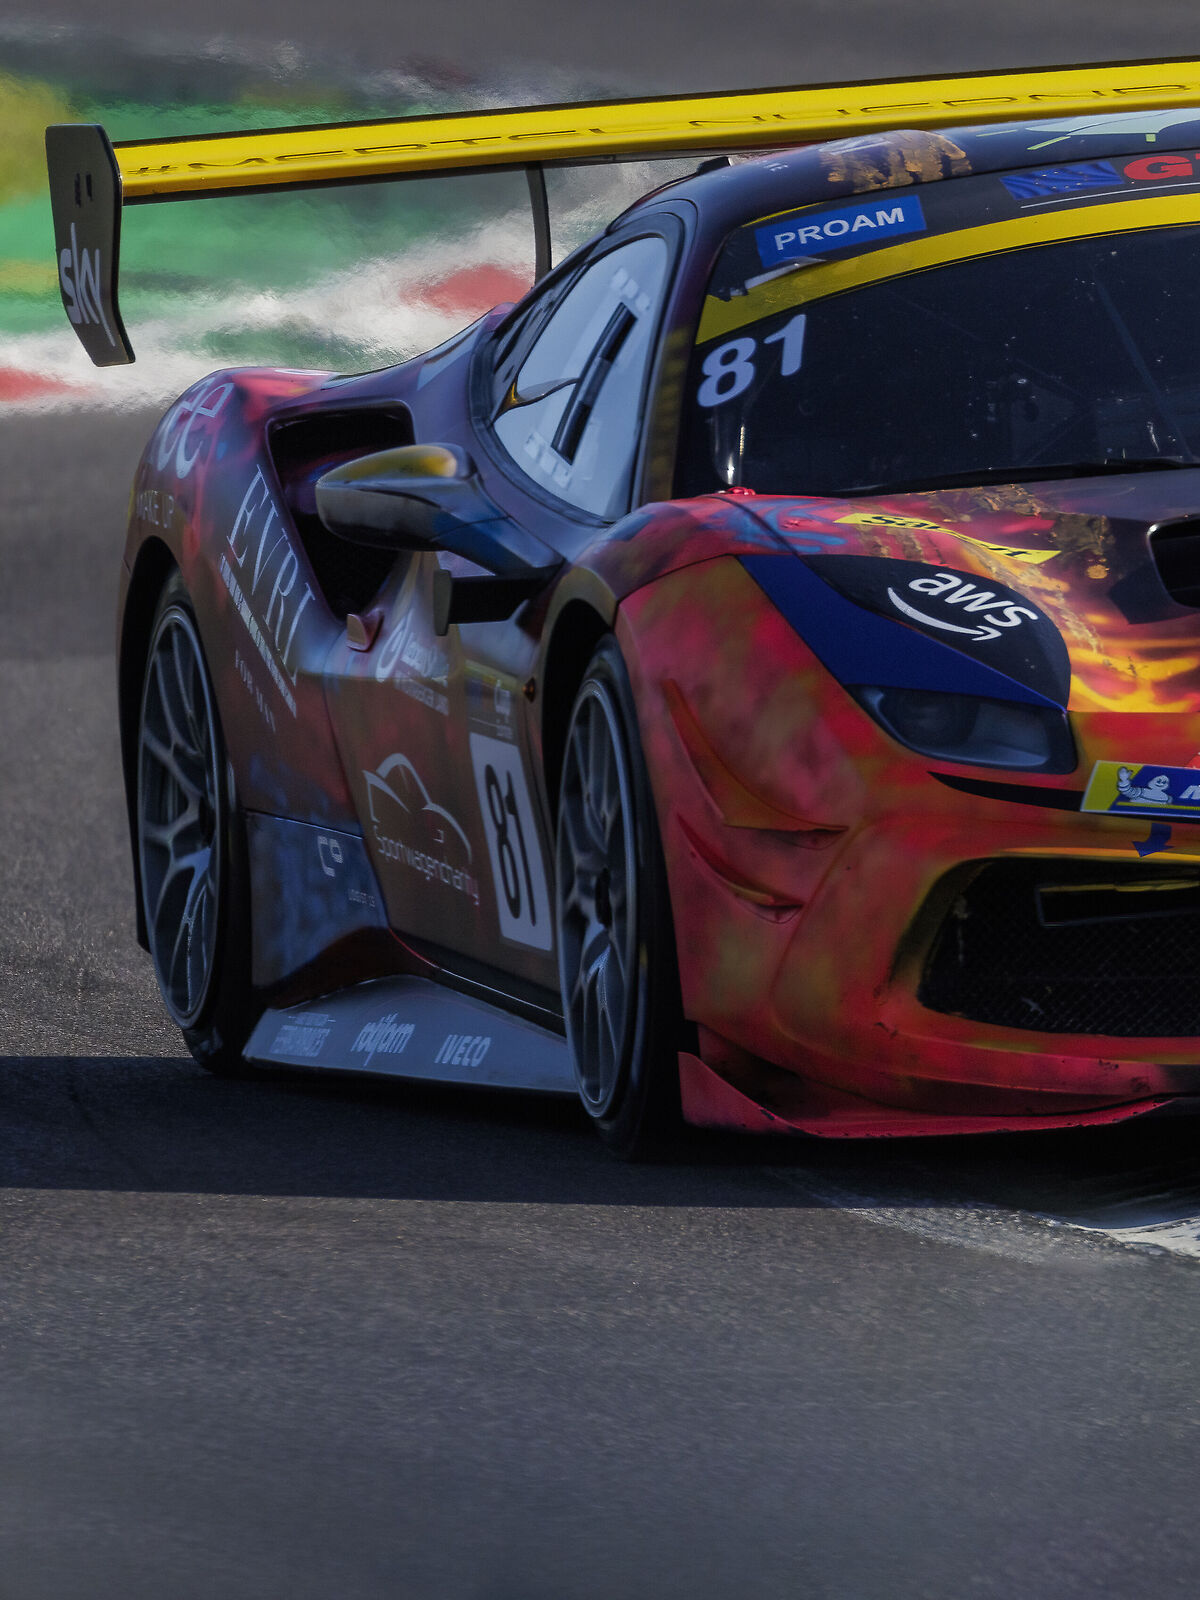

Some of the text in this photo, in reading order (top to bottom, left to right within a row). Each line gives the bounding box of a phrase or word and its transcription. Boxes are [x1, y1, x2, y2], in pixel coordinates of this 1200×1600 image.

[774, 207, 905, 251] PROAM
[60, 222, 116, 347] sky
[697, 313, 807, 408] 81
[907, 572, 1041, 630] aws
[484, 764, 537, 928] 81
[434, 1034, 492, 1068] IVECO
